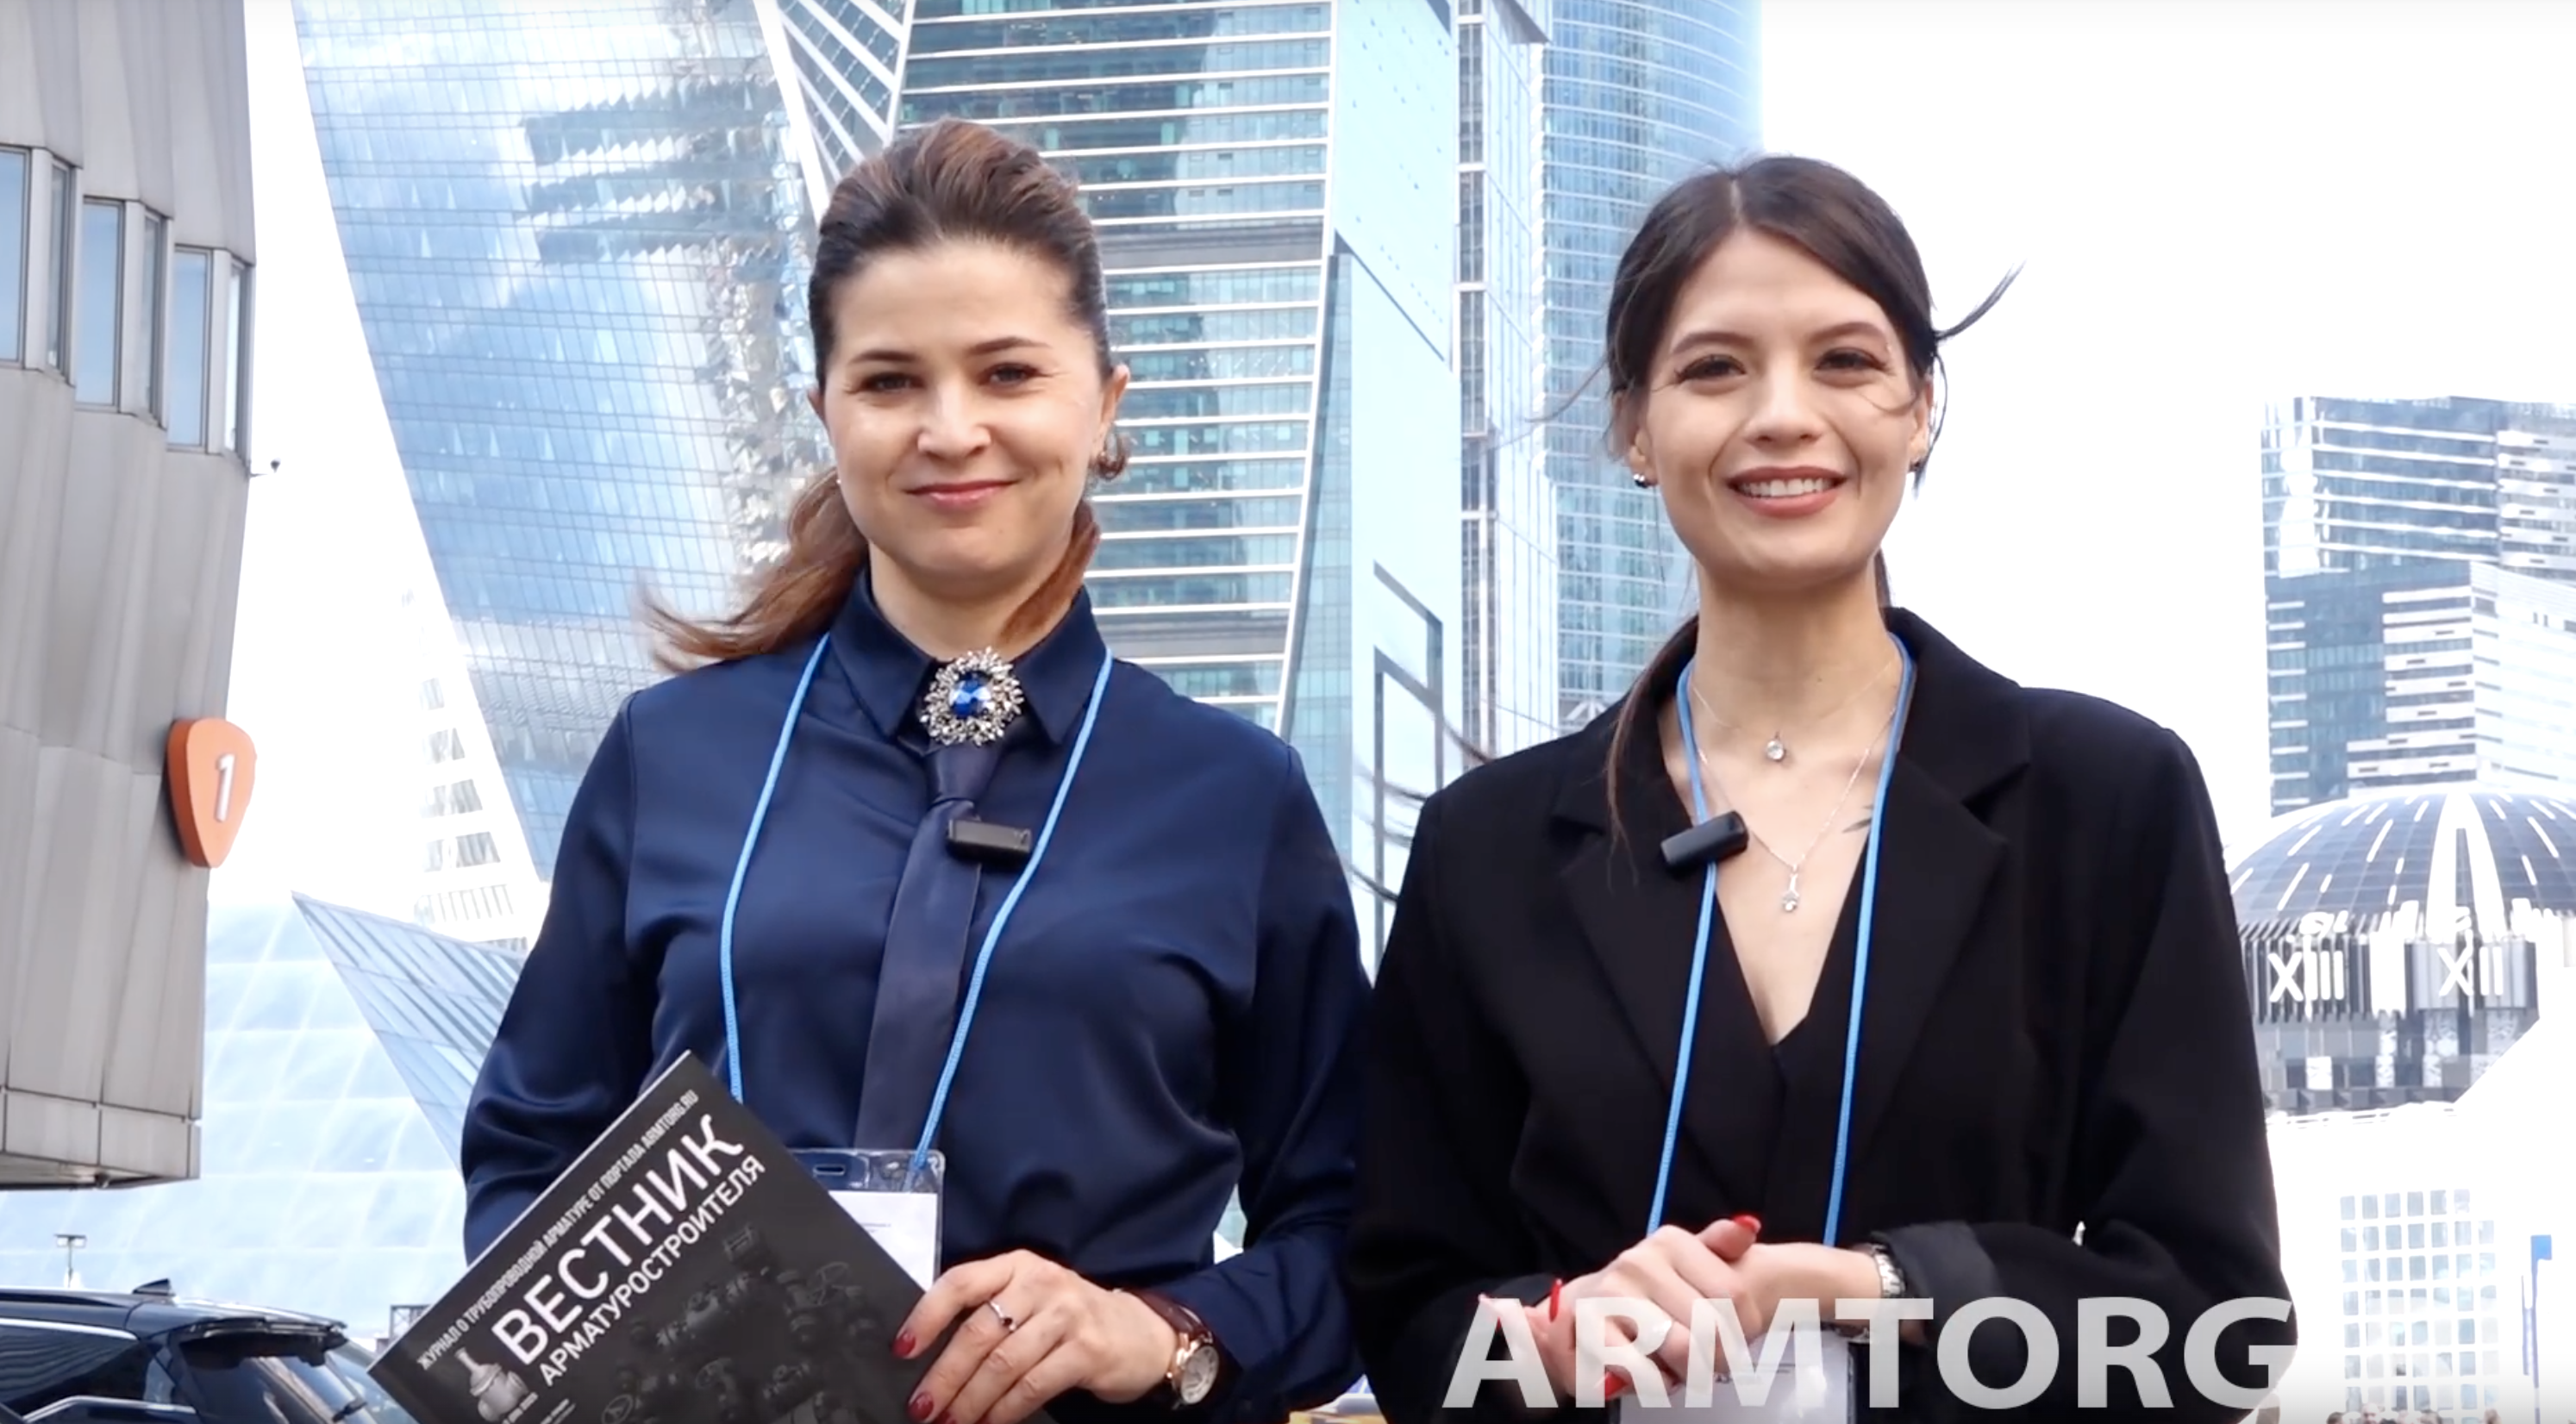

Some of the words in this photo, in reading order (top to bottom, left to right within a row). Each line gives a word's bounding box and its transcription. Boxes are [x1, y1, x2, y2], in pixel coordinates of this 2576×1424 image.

[215, 753, 234, 821] 1
[417, 1328, 461, 1371] ЖУРНАЛ
[456, 1319, 469, 1332] О
[464, 1240, 547, 1323] ТРУБОПРОВОДНОЙ
[542, 1194, 594, 1247] АРМАТУРЕ
[587, 1182, 605, 1201] ОТ
[600, 1144, 646, 1189] ПОРТАЛА
[641, 1090, 698, 1148] ARMTORG.RU
[491, 1114, 744, 1365] ВЕСТНИК
[539, 1155, 766, 1386] АРМАТУРОСТРОИТЕЛЯ
